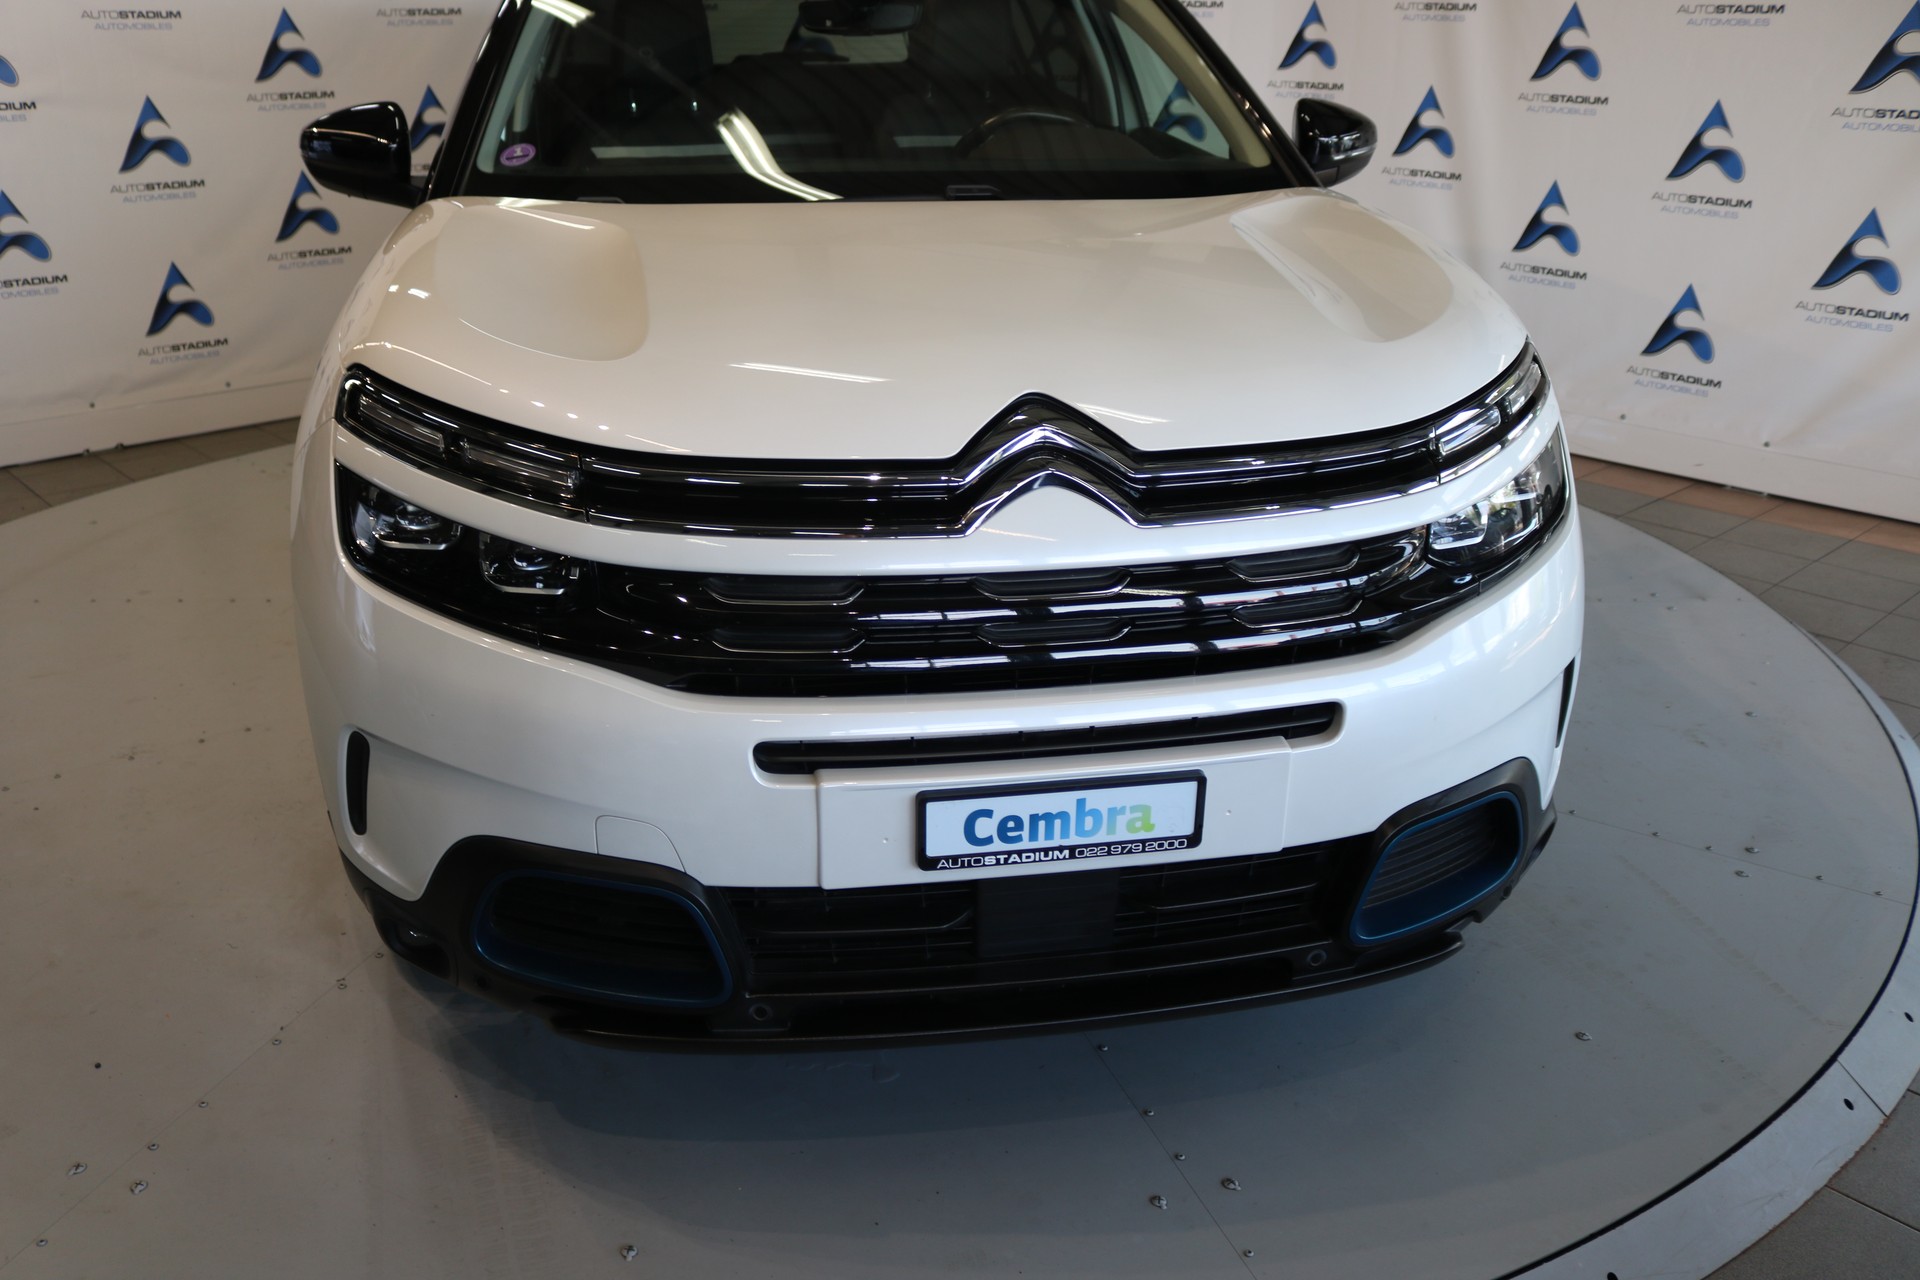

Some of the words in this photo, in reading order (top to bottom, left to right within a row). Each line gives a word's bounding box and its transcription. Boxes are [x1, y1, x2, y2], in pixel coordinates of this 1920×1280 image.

[376, 7, 462, 17] AUTOSTADIUM
[1394, 1, 1477, 11] AUTOSTADIUM
[1677, 3, 1785, 14] AUTOSTADIUM
[81, 9, 181, 19] AUTOSTADIUM
[94, 22, 172, 31] AUTOMOBILES
[1686, 18, 1770, 27] AUTOMOBILES
[1267, 79, 1344, 91] AUTOSTADIUM
[246, 90, 334, 103] AUTOSTADIUM
[1518, 91, 1609, 106] AUTOSTADIUM
[1526, 104, 1598, 117] AUTOMOBILES
[1382, 166, 1461, 182] AUTOSTADIUM
[110, 179, 205, 194] AUTOSTADIUM
[122, 191, 196, 204] AUTOMOBILES
[1651, 191, 1752, 209] AUTOSTADIUM
[1660, 204, 1739, 219] AUTOMOBILES
[267, 245, 352, 262] AUTOSTADIUM
[1500, 261, 1588, 281] AUTOSTADIUM
[1795, 300, 1909, 322] AUTOSTADIUM
[1804, 314, 1894, 332] AUTOMOBILES
[138, 337, 228, 357] AUTOSTADIUM
[1626, 365, 1722, 389] AUTOSTADIUM
[963, 797, 1155, 847] Cembra
[937, 849, 1069, 869] AUTOSTADIUM
[1075, 845, 1108, 858] 022
[1111, 842, 1143, 855] 979
[1145, 838, 1187, 852] 2000
